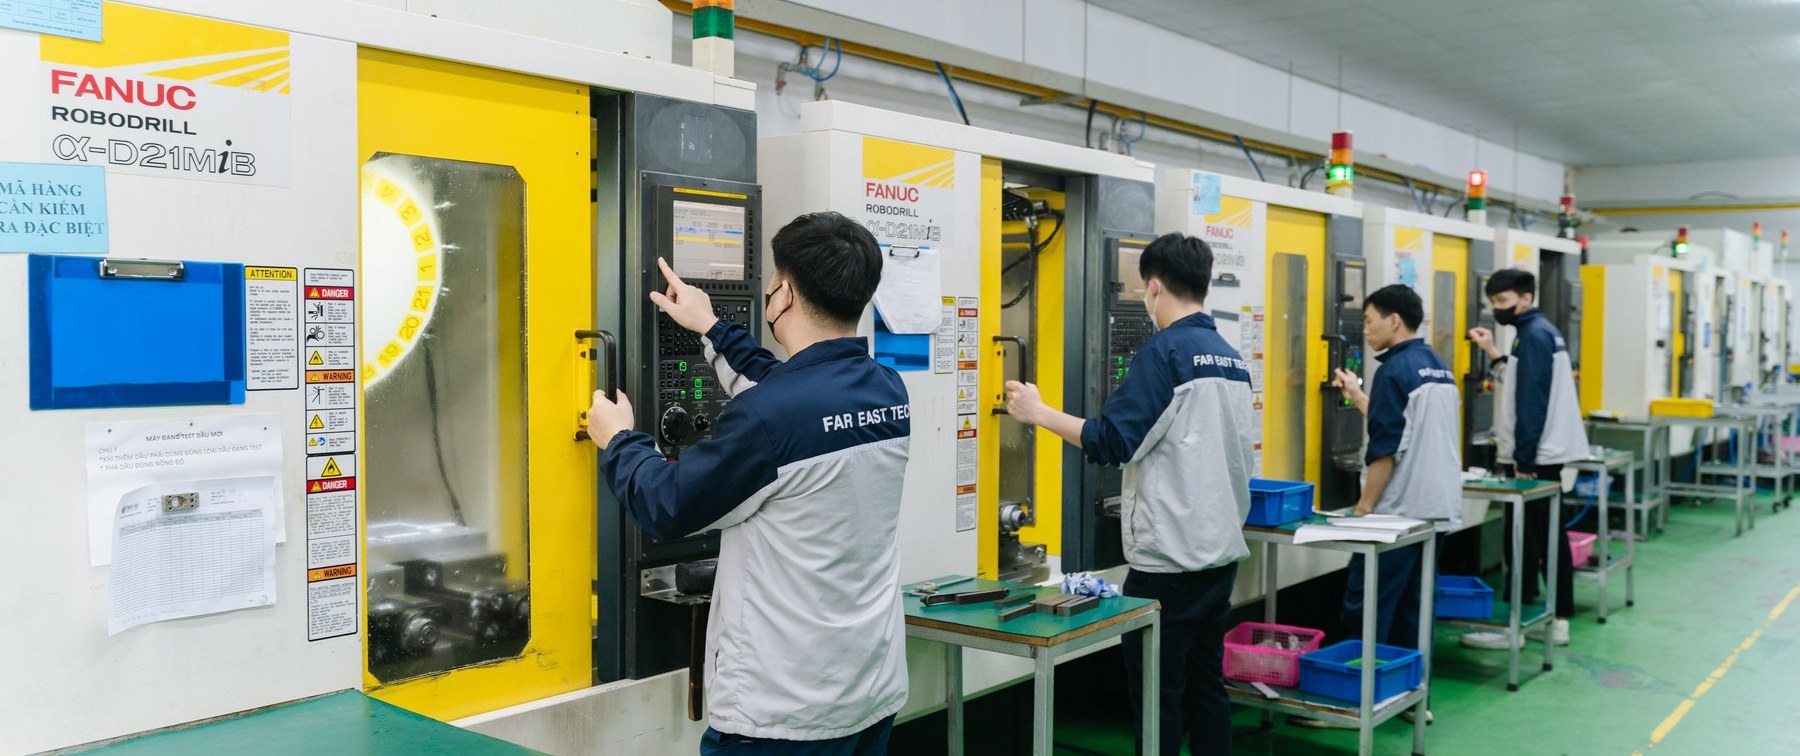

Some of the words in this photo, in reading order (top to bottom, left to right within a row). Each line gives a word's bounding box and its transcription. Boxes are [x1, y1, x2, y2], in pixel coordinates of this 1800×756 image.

[51, 69, 197, 111] FANUC
[51, 106, 197, 135] ROBODRILL
[0, 179, 26, 195] MÃ
[32, 180, 82, 197] HÀNG
[866, 182, 919, 203] FANUC
[401, 205, 416, 220] 3
[866, 203, 919, 218] ROBODRILL
[414, 231, 430, 246] 2
[1206, 225, 1234, 239] FANUC
[250, 269, 292, 279] ATTENTION
[321, 288, 349, 298] DANGER
[413, 290, 431, 310] 21
[399, 316, 420, 340] 20
[379, 343, 400, 363] 19
[1193, 354, 1214, 366] FAR
[323, 372, 352, 380] WARNING
[822, 413, 854, 432] FAR
[857, 407, 887, 427] EAST
[181, 432, 195, 440] TEST
[322, 480, 348, 490] DANGER
[323, 566, 352, 578] WARNING
